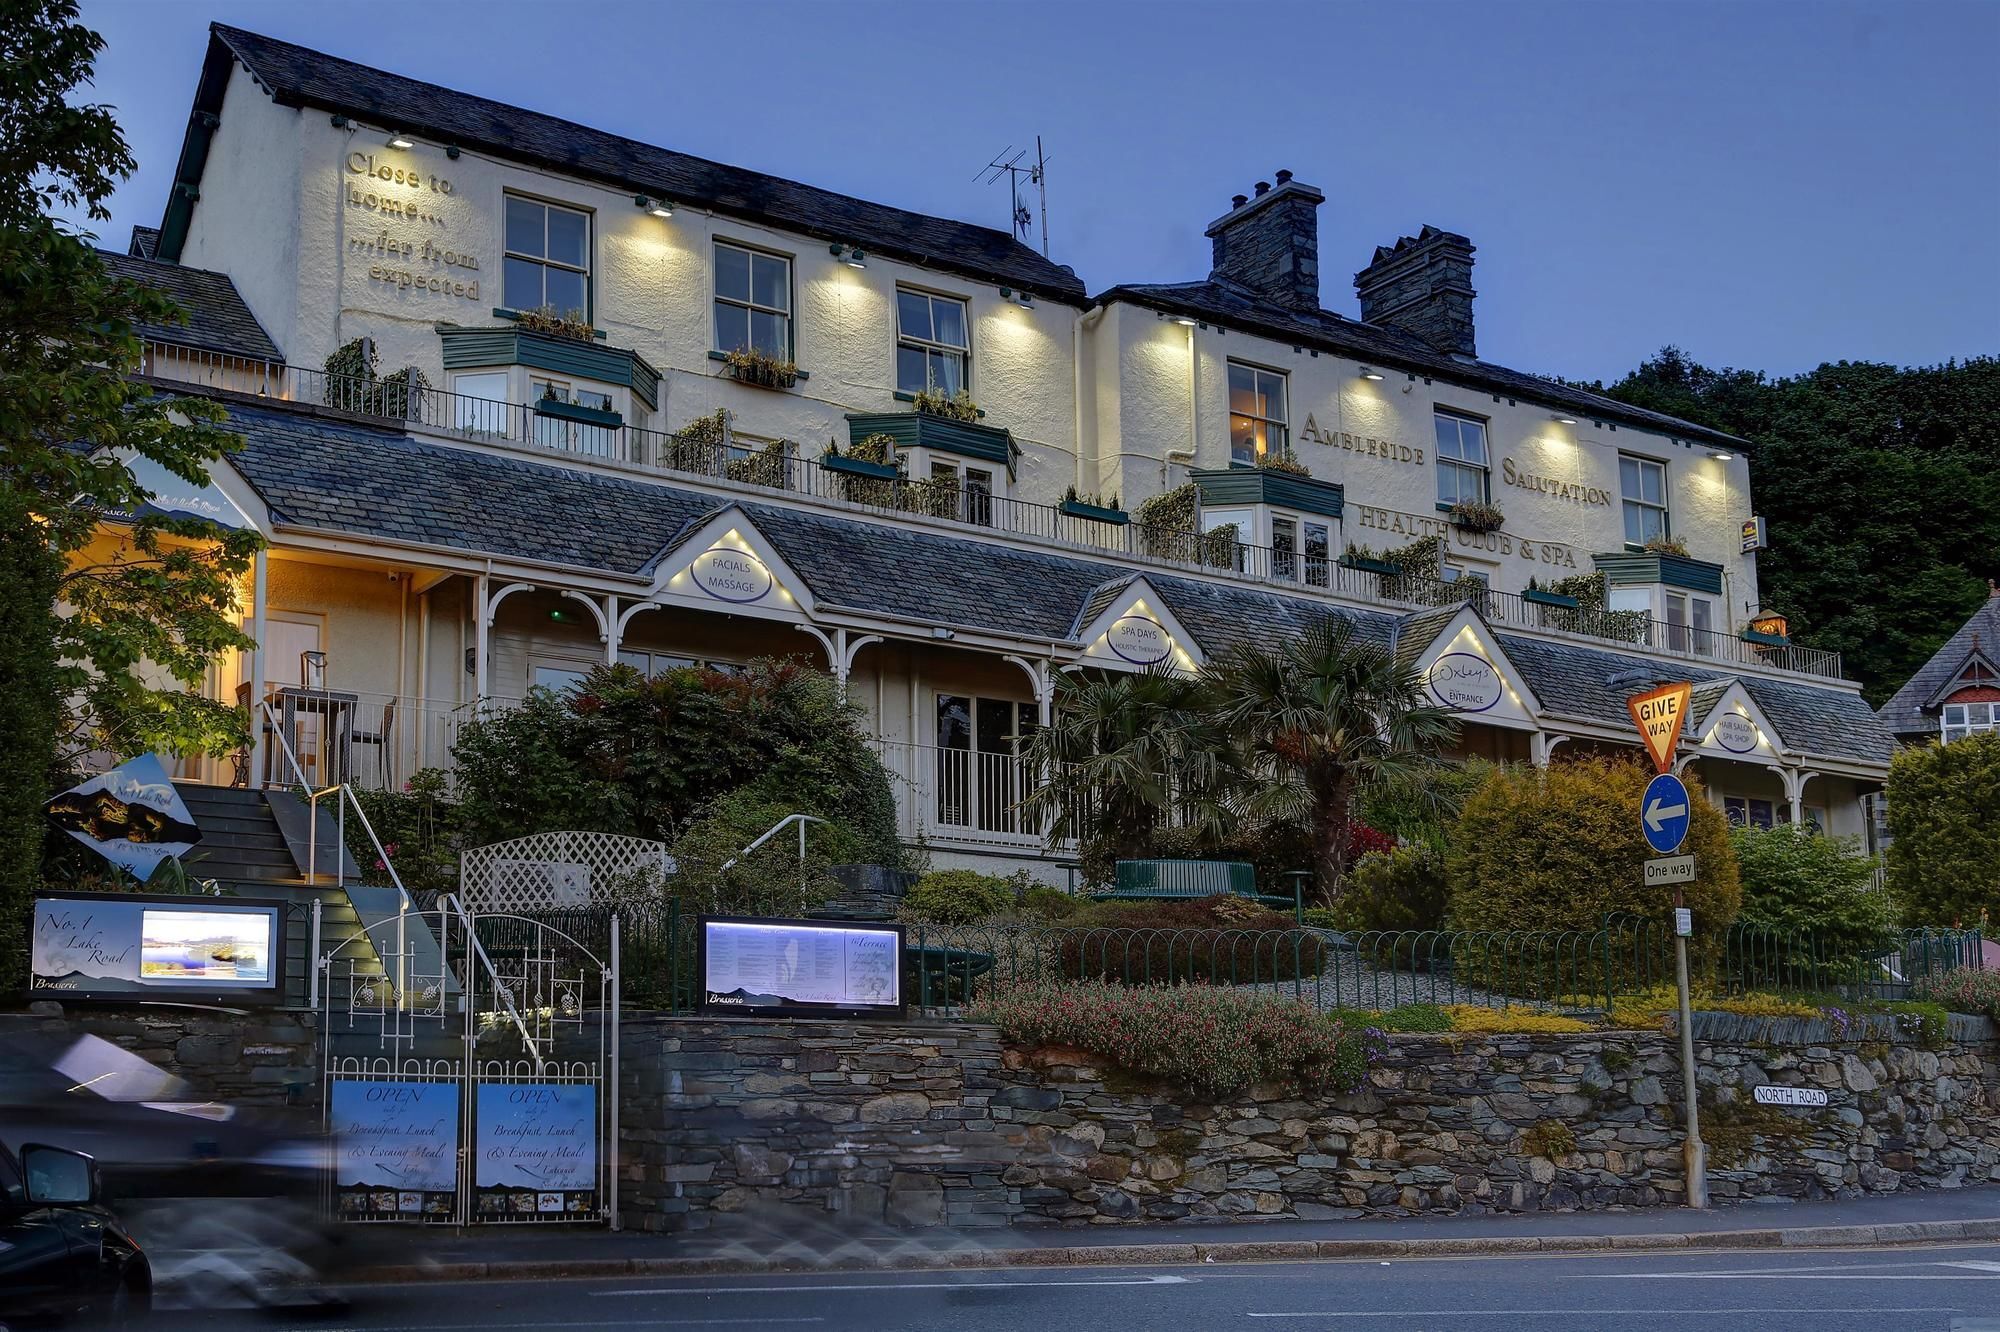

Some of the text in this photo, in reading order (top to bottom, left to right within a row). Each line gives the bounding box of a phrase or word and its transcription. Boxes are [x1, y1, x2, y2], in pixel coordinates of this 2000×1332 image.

[348, 152, 453, 194] Close to
[421, 239, 480, 271] from
[368, 263, 480, 301] expected
[1359, 505, 1577, 569] HEALTH CLUB & SPA
[712, 558, 751, 574] FACIALS
[707, 577, 755, 593] MASSAGE
[1121, 626, 1157, 640] SPA DAYS
[1440, 664, 1489, 684] Oxley's
[1449, 691, 1484, 704] ENTRANCE
[1639, 696, 1678, 721] GIVE
[1648, 719, 1674, 738] WAY
[1719, 721, 1753, 733] HAIR SALON
[1723, 732, 1750, 743] SPA SHOP
[1646, 861, 1693, 878] One way
[66, 931, 103, 951] Lake
[87, 944, 135, 966] Road
[34, 977, 79, 990] Brasserie
[709, 993, 745, 1005] Brasserie
[366, 1086, 428, 1105] OPEN
[509, 1088, 562, 1105] OPEN
[1757, 1087, 1826, 1105] NORTH ROAD
[406, 1118, 446, 1137] Lunch
[547, 1118, 585, 1137] Lunch
[369, 1144, 410, 1168] Evening
[486, 1141, 587, 1169] & Evening Meals
